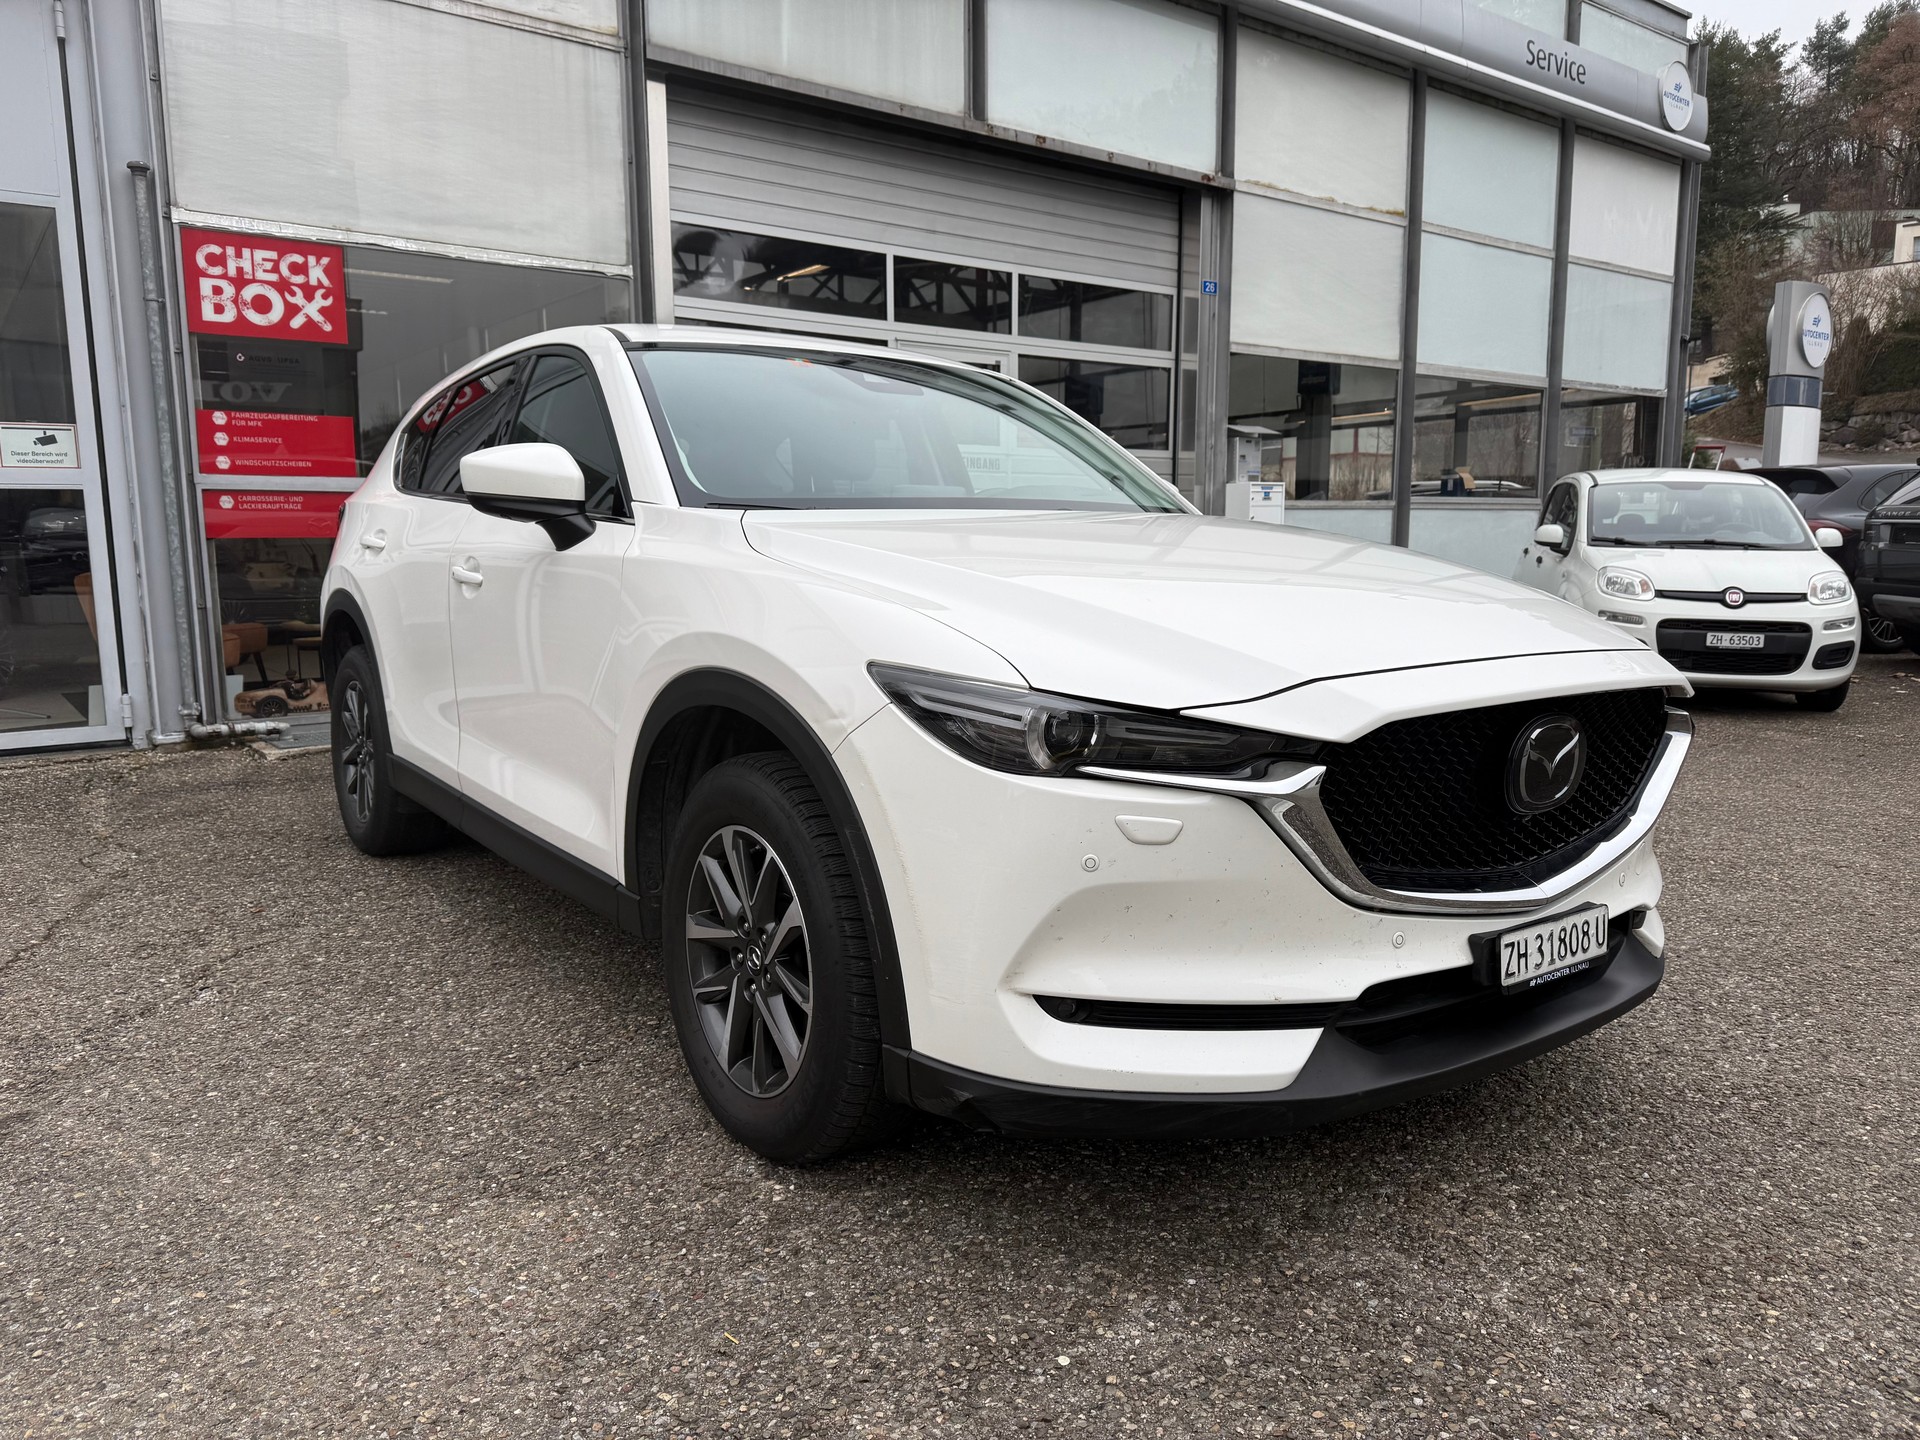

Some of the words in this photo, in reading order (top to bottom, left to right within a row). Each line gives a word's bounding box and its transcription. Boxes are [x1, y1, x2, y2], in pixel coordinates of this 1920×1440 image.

[1526, 39, 1587, 85] Service
[1663, 90, 1690, 108] AUTOCENTER
[195, 243, 333, 288] CHECK
[198, 276, 334, 332] BOX
[231, 411, 318, 422] FAHRZEUGAUFBEREITUNG
[232, 418, 246, 427] FÜR
[233, 436, 283, 444] KLIMASERVICE
[234, 459, 312, 468] WINDSCHUTZSCHEIBEN
[238, 495, 287, 503] CARROSSERIE-
[238, 501, 302, 510] LACKIERAUFTRÄGE
[1535, 967, 1570, 985] AUTOCENTER
[1570, 960, 1590, 976] ILLNAU
